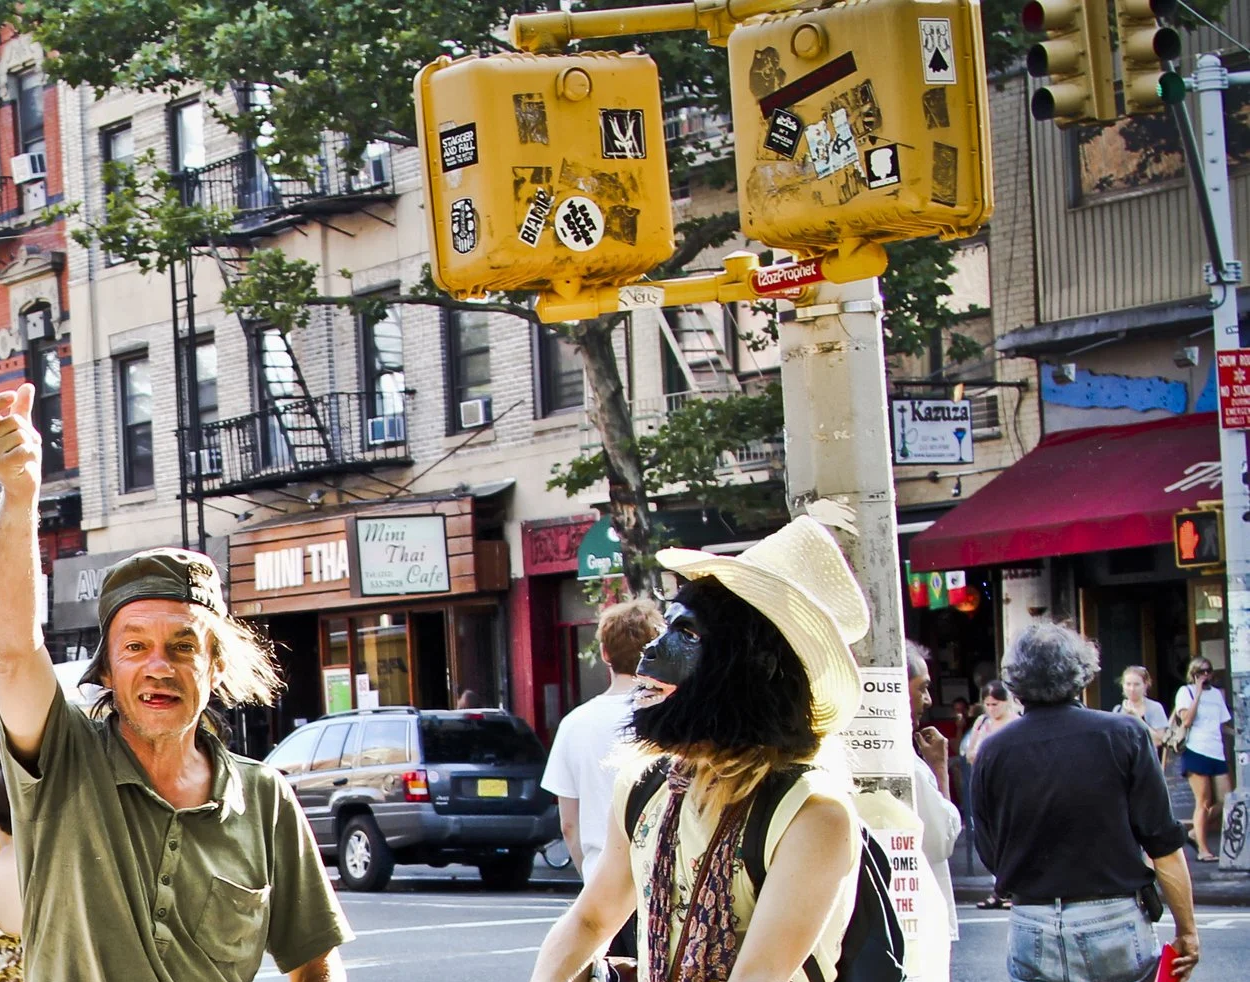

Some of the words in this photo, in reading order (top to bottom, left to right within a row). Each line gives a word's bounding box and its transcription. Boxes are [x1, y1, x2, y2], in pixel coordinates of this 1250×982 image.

[1218, 354, 1237, 367] SNOW
[1220, 385, 1230, 397] NO
[910, 400, 969, 422] Kazuza
[365, 522, 407, 542] Mini
[385, 544, 426, 563] Thai
[254, 547, 304, 591] MINI
[307, 539, 350, 583] THA
[407, 564, 444, 587] Cafe
[863, 681, 902, 693] OUSE
[868, 705, 896, 716] Street
[850, 739, 895, 750] 9-8577
[890, 836, 915, 851] LOVE
[892, 856, 918, 871] OMES
[894, 877, 906, 892] UT
[895, 898, 914, 913] THE
